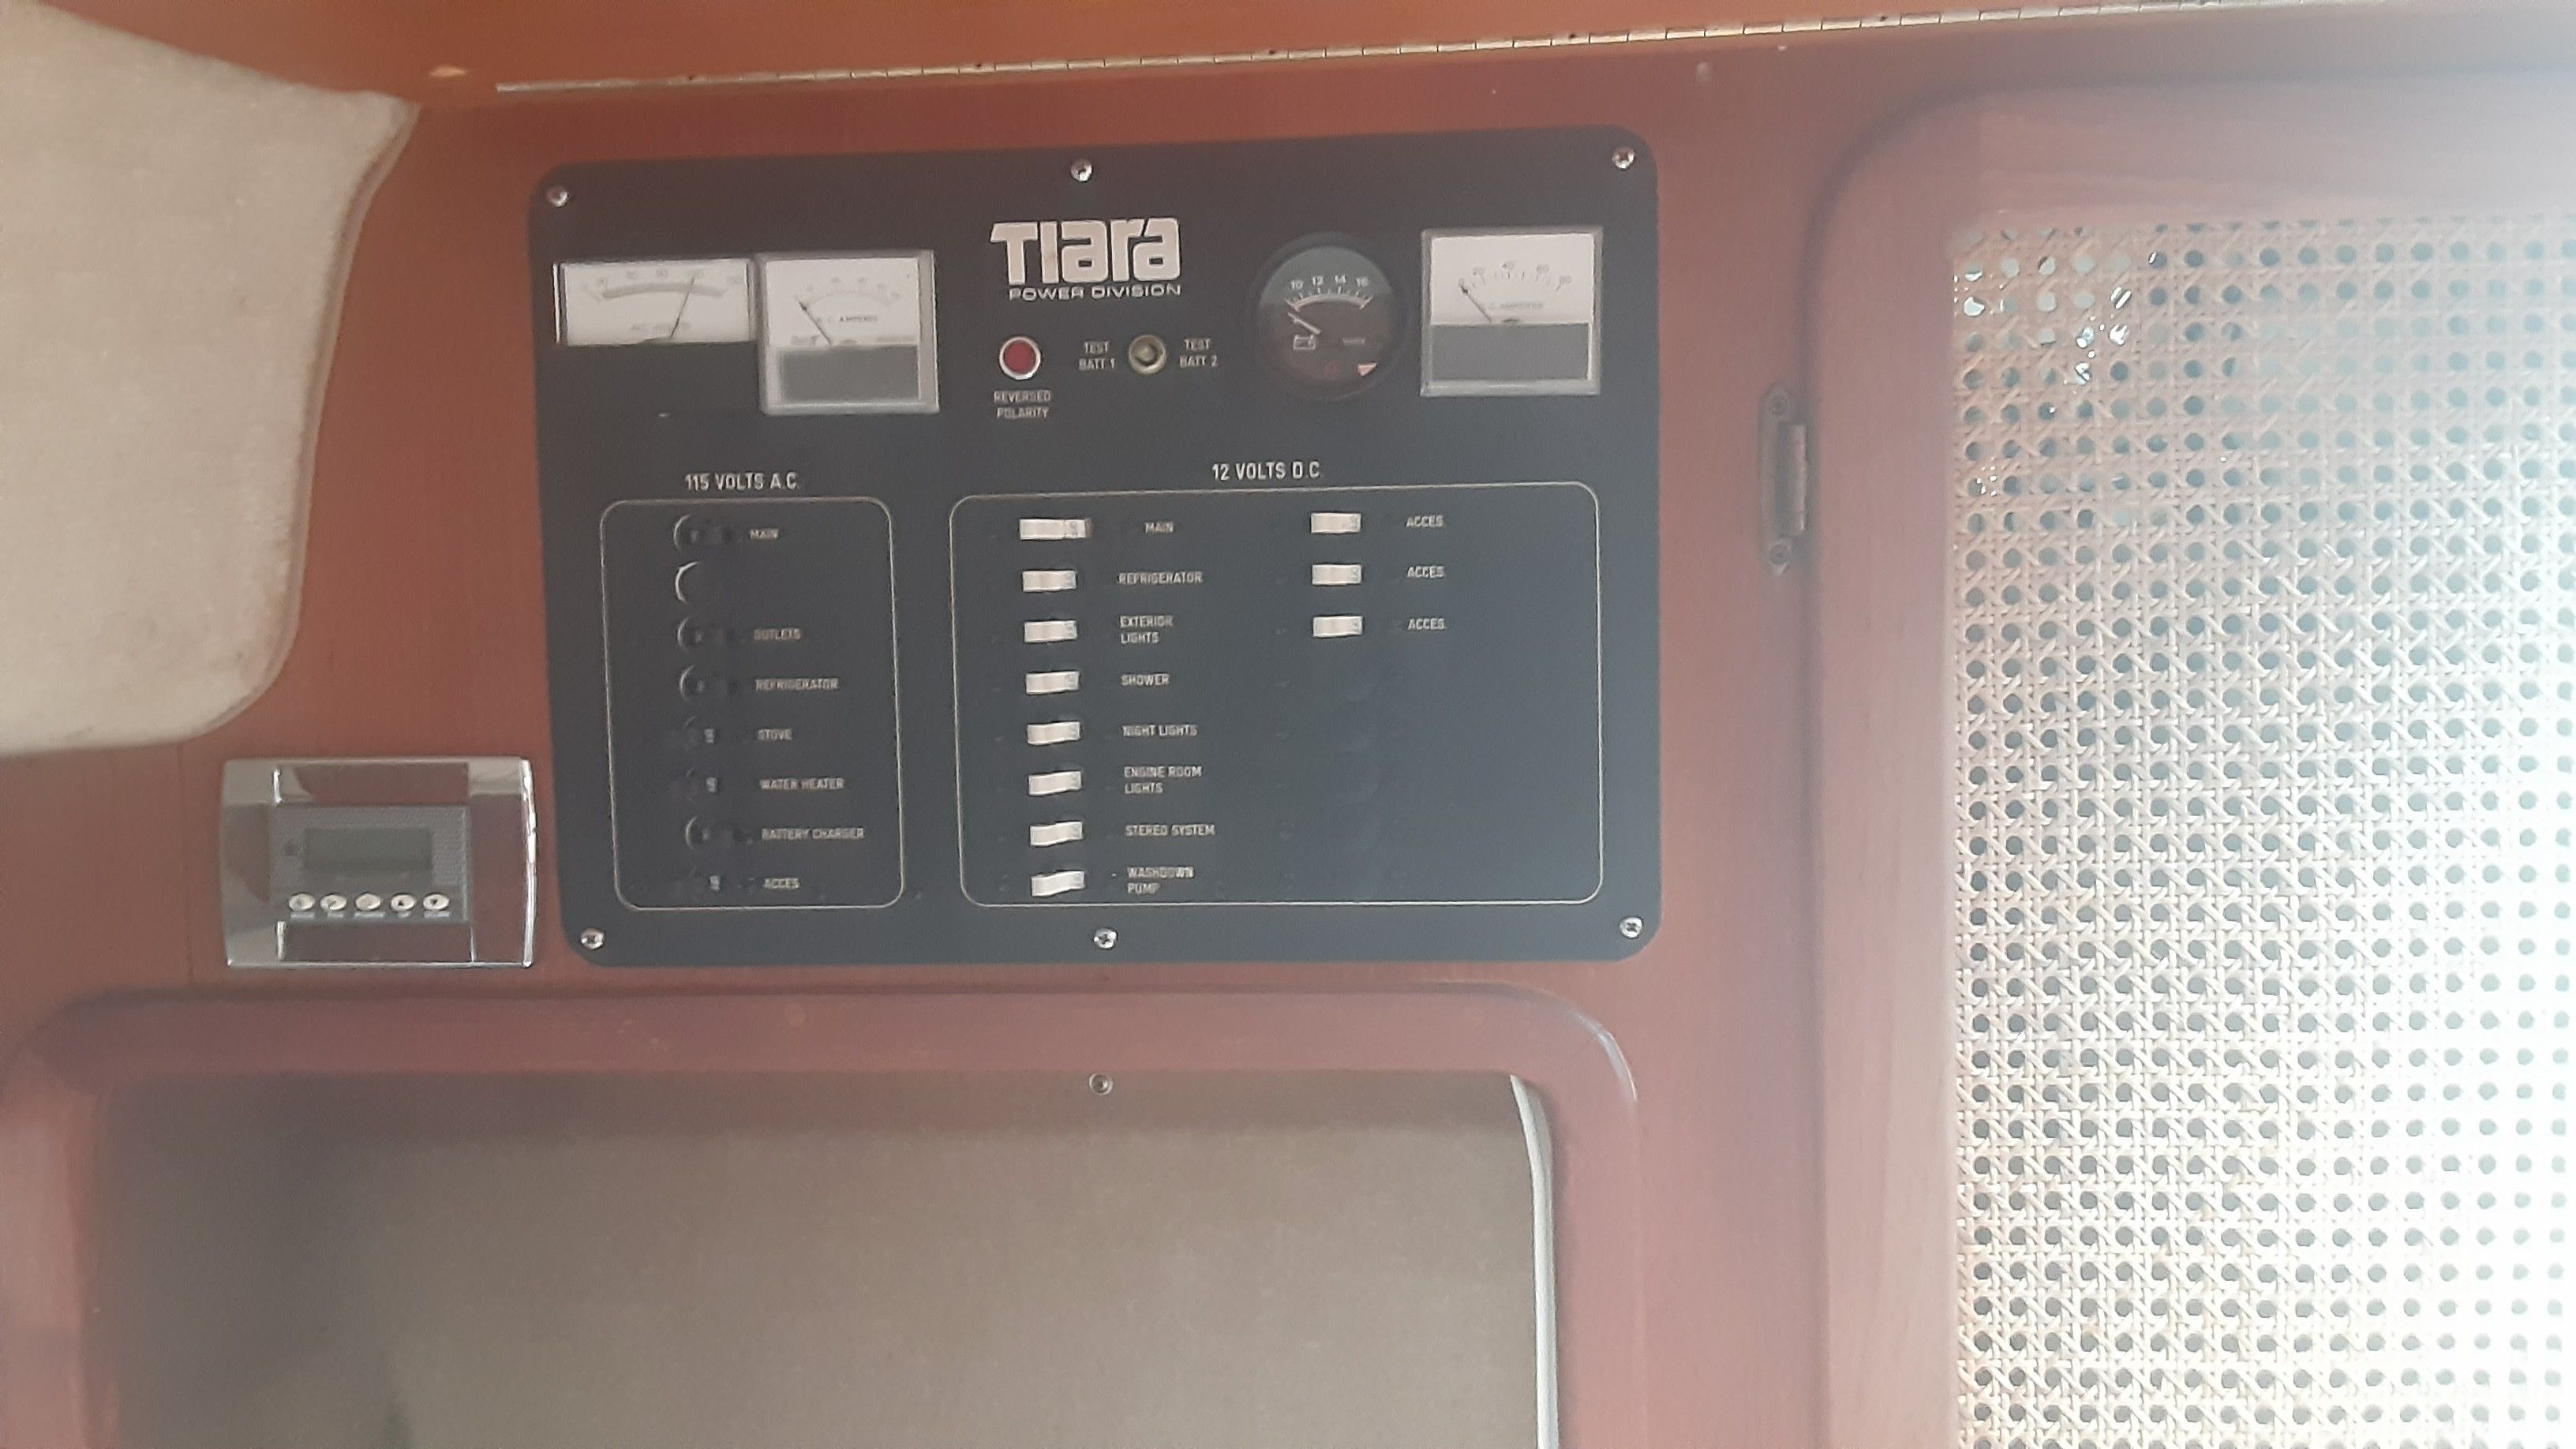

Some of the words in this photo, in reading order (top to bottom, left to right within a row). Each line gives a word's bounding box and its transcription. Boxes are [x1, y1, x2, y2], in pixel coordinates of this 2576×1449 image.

[1290, 279, 1304, 290] 10
[1334, 274, 1346, 284] 14
[1009, 286, 1085, 301] POWER
[1091, 283, 1182, 298] DIVISION
[1084, 341, 1110, 355] TEST
[1185, 339, 1211, 352] TEST
[994, 390, 1052, 404] REVERSED
[996, 407, 1050, 421] POLARITY
[1212, 463, 1230, 481] 12
[1236, 462, 1287, 481] VOLTS
[685, 473, 710, 492] 115
[714, 472, 765, 492] VOLTS
[750, 528, 781, 541] MAIN
[1145, 521, 1175, 535] MAIN
[1118, 571, 1204, 586] REFRIGERATOR
[1120, 615, 1174, 629] EXTERIOR
[754, 628, 803, 642] OUTLETS
[1121, 632, 1160, 645] LIGHTS
[755, 677, 840, 692] REFRIGERATOR
[1121, 673, 1171, 687] SHOWER
[758, 728, 794, 742] STOVE
[1123, 724, 1156, 737] NIGHT
[1159, 724, 1198, 737] LIGHTS
[1124, 766, 1166, 780] ENGINE
[1168, 766, 1203, 779] ROOM
[760, 779, 795, 792] WATER
[802, 777, 846, 791] HEATER
[1125, 783, 1164, 796] LIGHTS
[762, 828, 810, 841] BATTERY
[812, 827, 865, 841] CHARGER
[1125, 824, 1169, 837] STEREO
[1171, 824, 1216, 837] SYSTEM
[1127, 867, 1195, 879] WASHDOWN
[1128, 882, 1161, 896] PUMP
